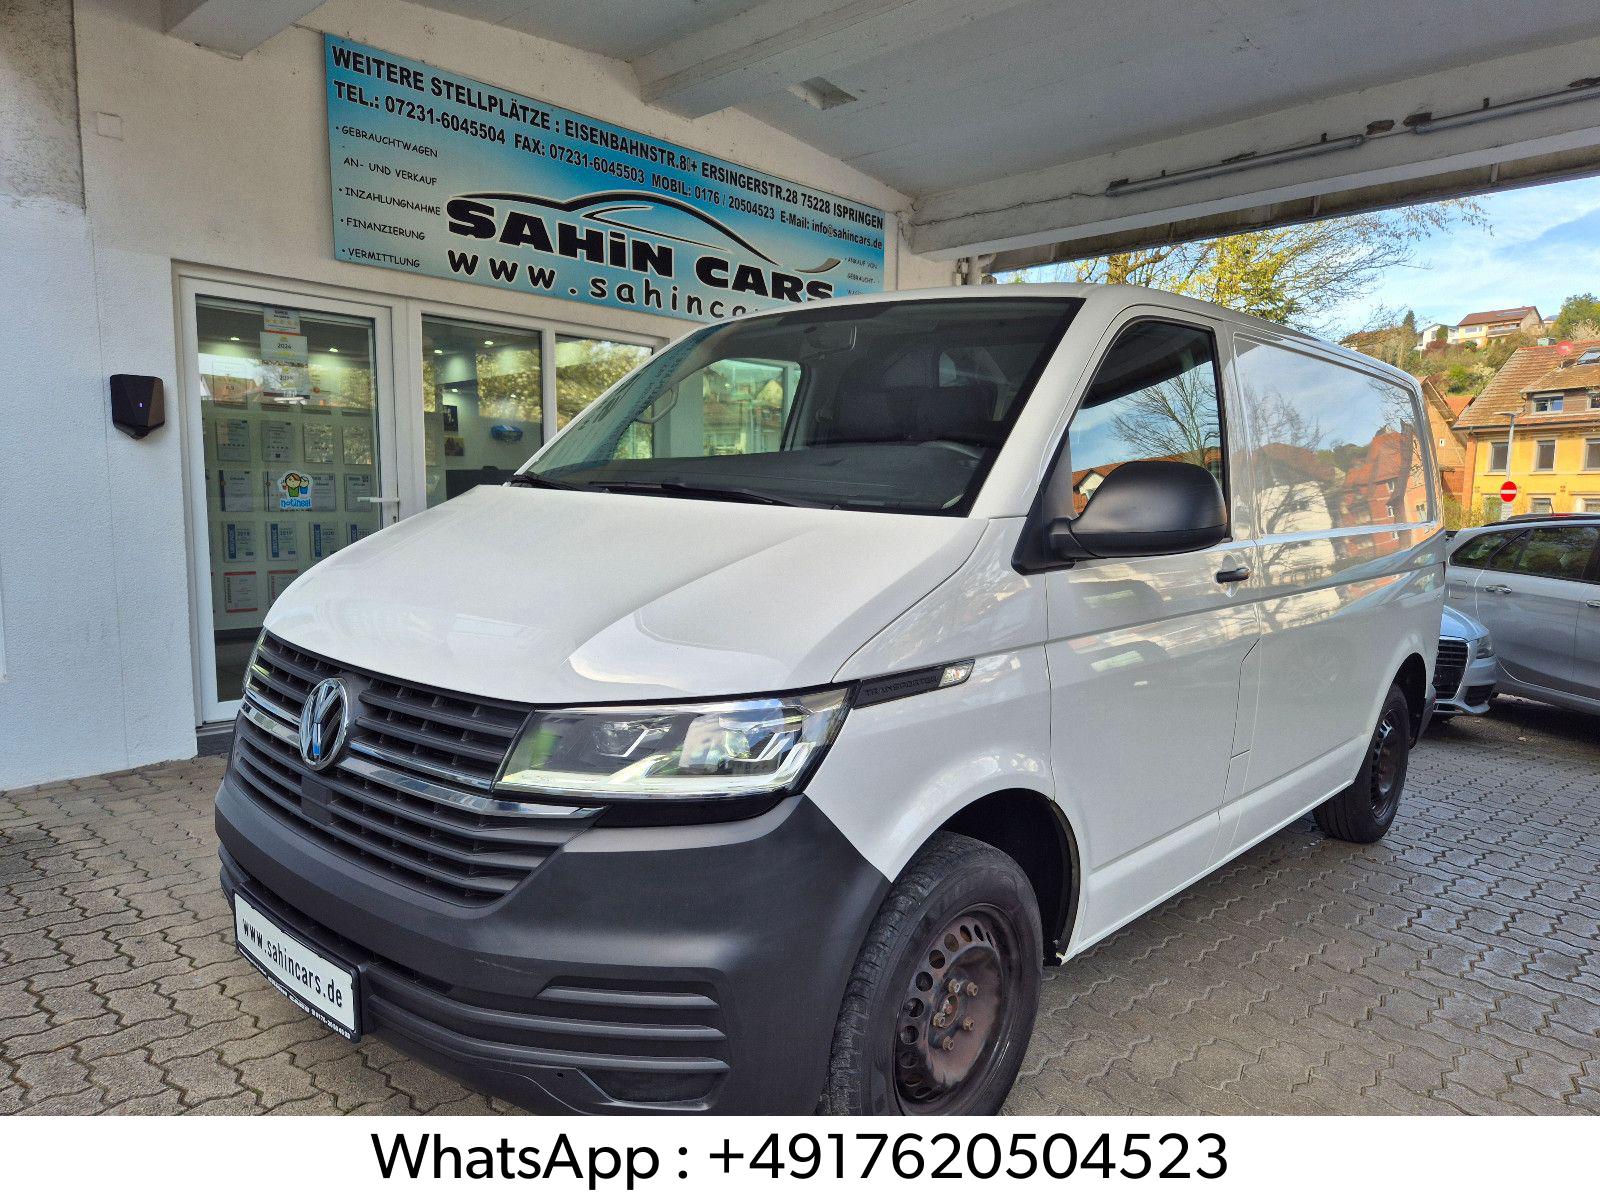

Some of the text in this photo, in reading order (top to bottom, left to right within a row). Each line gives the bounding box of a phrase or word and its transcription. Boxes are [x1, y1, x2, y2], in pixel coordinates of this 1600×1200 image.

[332, 45, 425, 92] WEITERE
[430, 76, 551, 131] STELLPLÄTZE
[701, 161, 798, 205] ERSINGERSTR.28
[801, 192, 831, 215] 75228
[833, 202, 884, 230] ISPRINGEN
[341, 125, 438, 158] GEBRAUCHTWAGEN
[334, 80, 379, 108] TEL.:
[385, 95, 506, 145] 07231-6045504
[514, 133, 546, 156] FAX:
[549, 143, 645, 184] 07231-6045503
[651, 172, 691, 197] MOBIL:
[694, 185, 720, 205] 0176
[728, 195, 775, 220] 20504523
[780, 212, 810, 231] E-Mail:
[811, 218, 883, 250] info@sahincars.de
[343, 157, 438, 186] AN- UND VERKAUF
[345, 186, 441, 216] INZAHLUNGNAHME
[346, 217, 426, 241] FINANZIERUNG
[348, 247, 421, 268] VERMITTLUNG
[696, 255, 833, 303] CARS
[242, 918, 343, 1008] www.sahincars.de
